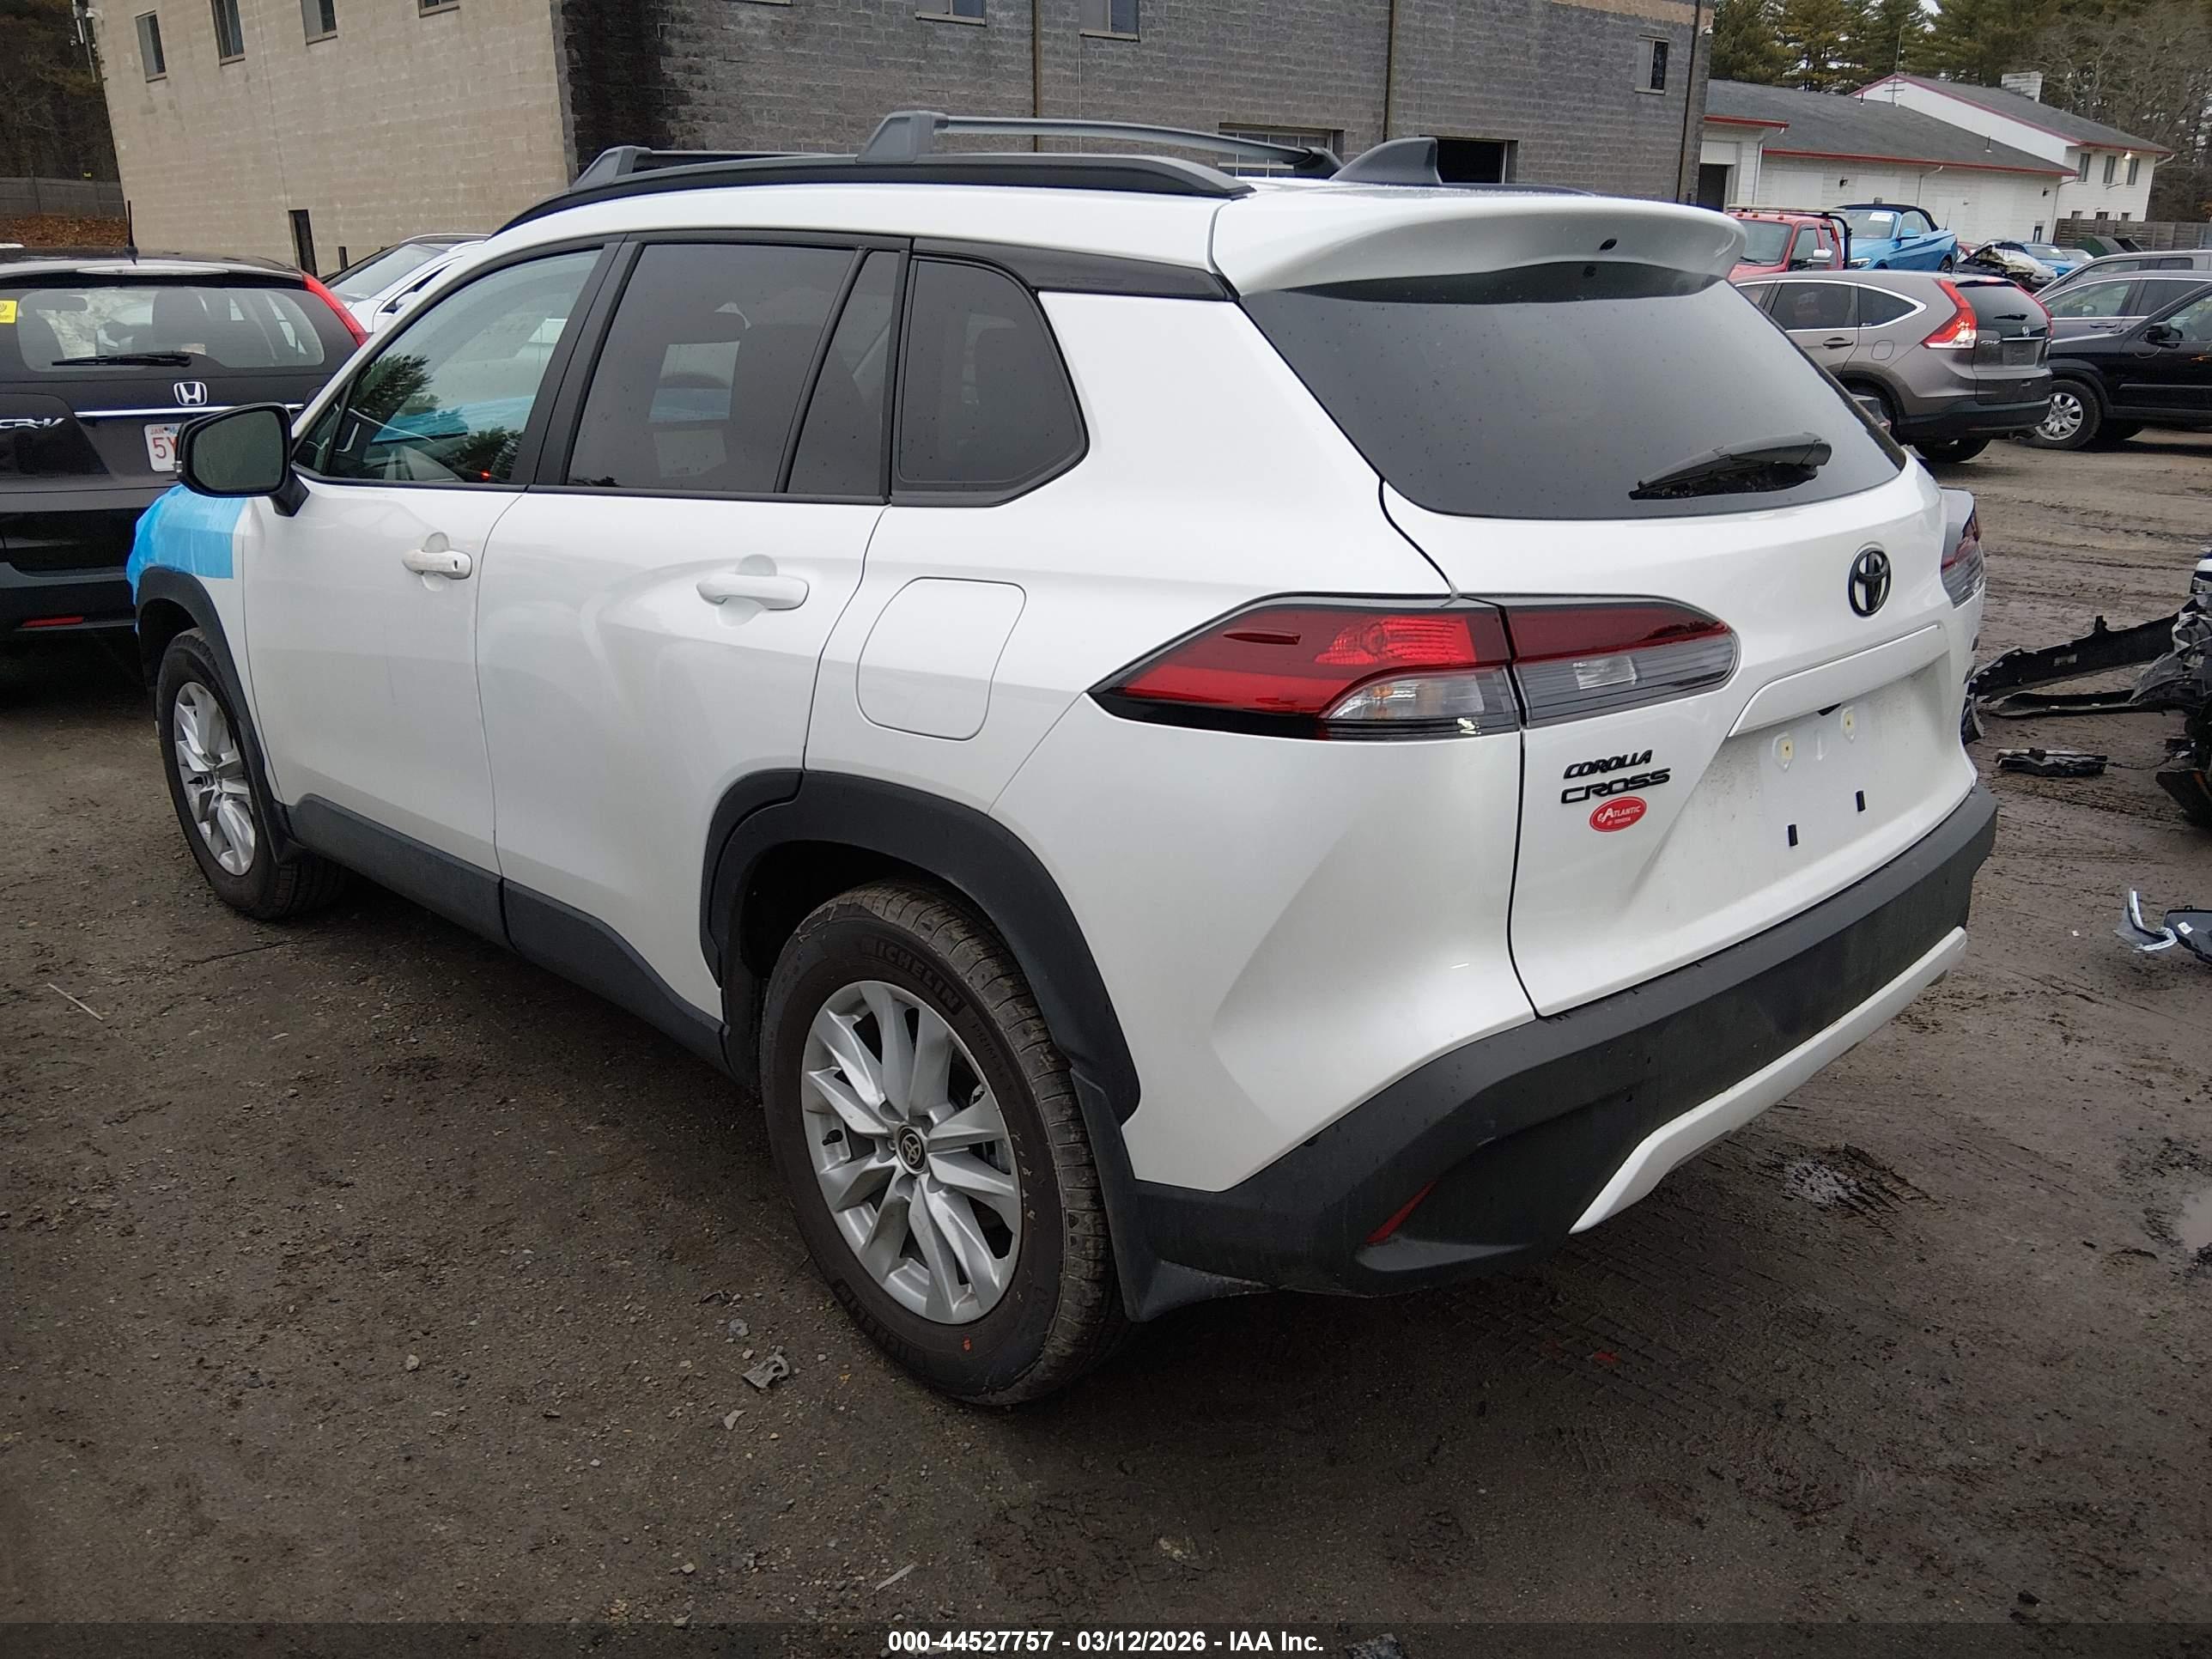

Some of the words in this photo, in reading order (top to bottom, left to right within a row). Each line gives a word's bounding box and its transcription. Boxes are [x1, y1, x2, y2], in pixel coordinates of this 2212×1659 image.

[1564, 750, 1652, 779] COROLLA
[1561, 769, 1670, 804] CROSS
[860, 935, 960, 1011] MICHELIN
